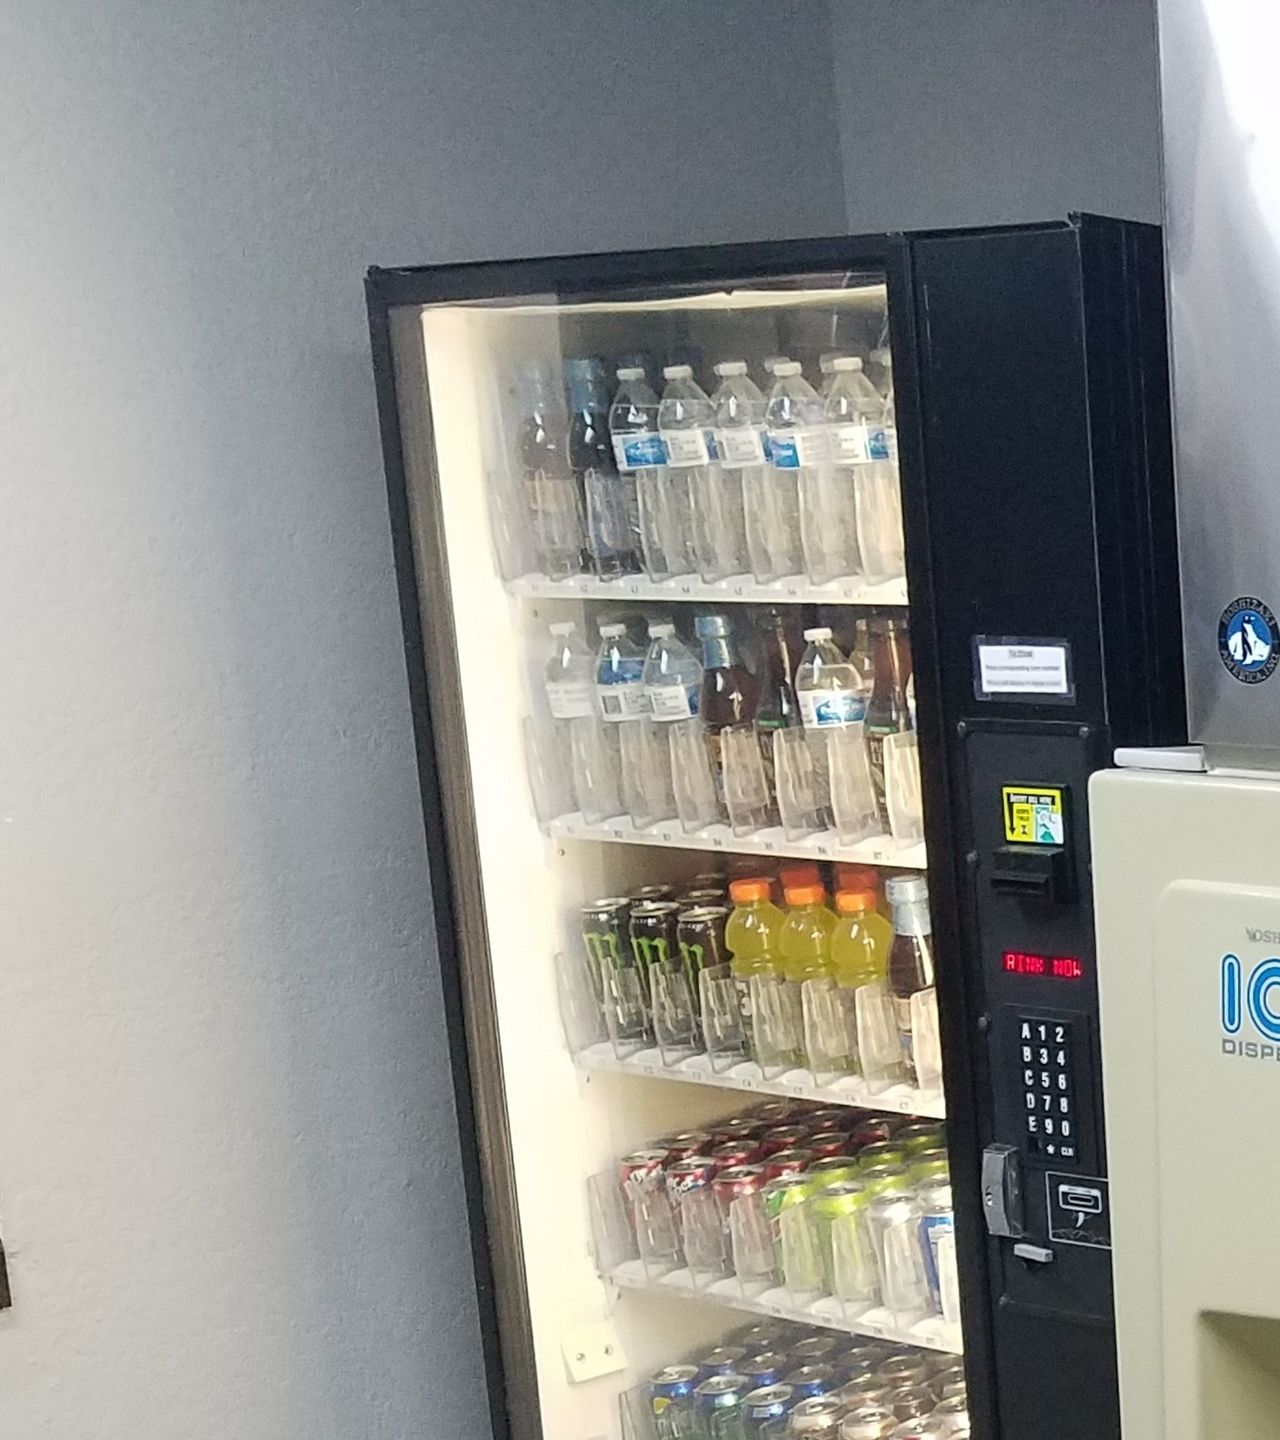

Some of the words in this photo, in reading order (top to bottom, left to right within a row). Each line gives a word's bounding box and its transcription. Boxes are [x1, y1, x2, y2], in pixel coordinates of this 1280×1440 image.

[1021, 1022, 1031, 1040] A
[1038, 1025, 1046, 1041] 1
[1055, 1026, 1065, 1043] 2
[1022, 1046, 1032, 1063] B
[1040, 1048, 1049, 1065] 3
[1056, 1050, 1066, 1067] 4
[1024, 1069, 1034, 1086] C
[1041, 1072, 1050, 1088] 5
[1058, 1073, 1067, 1090] 6
[1026, 1093, 1036, 1109] D
[1042, 1095, 1051, 1111] 7
[1060, 1097, 1069, 1114] 8
[1028, 1116, 1038, 1133] E
[1044, 1118, 1054, 1135] 9
[1061, 1120, 1071, 1137] 0
